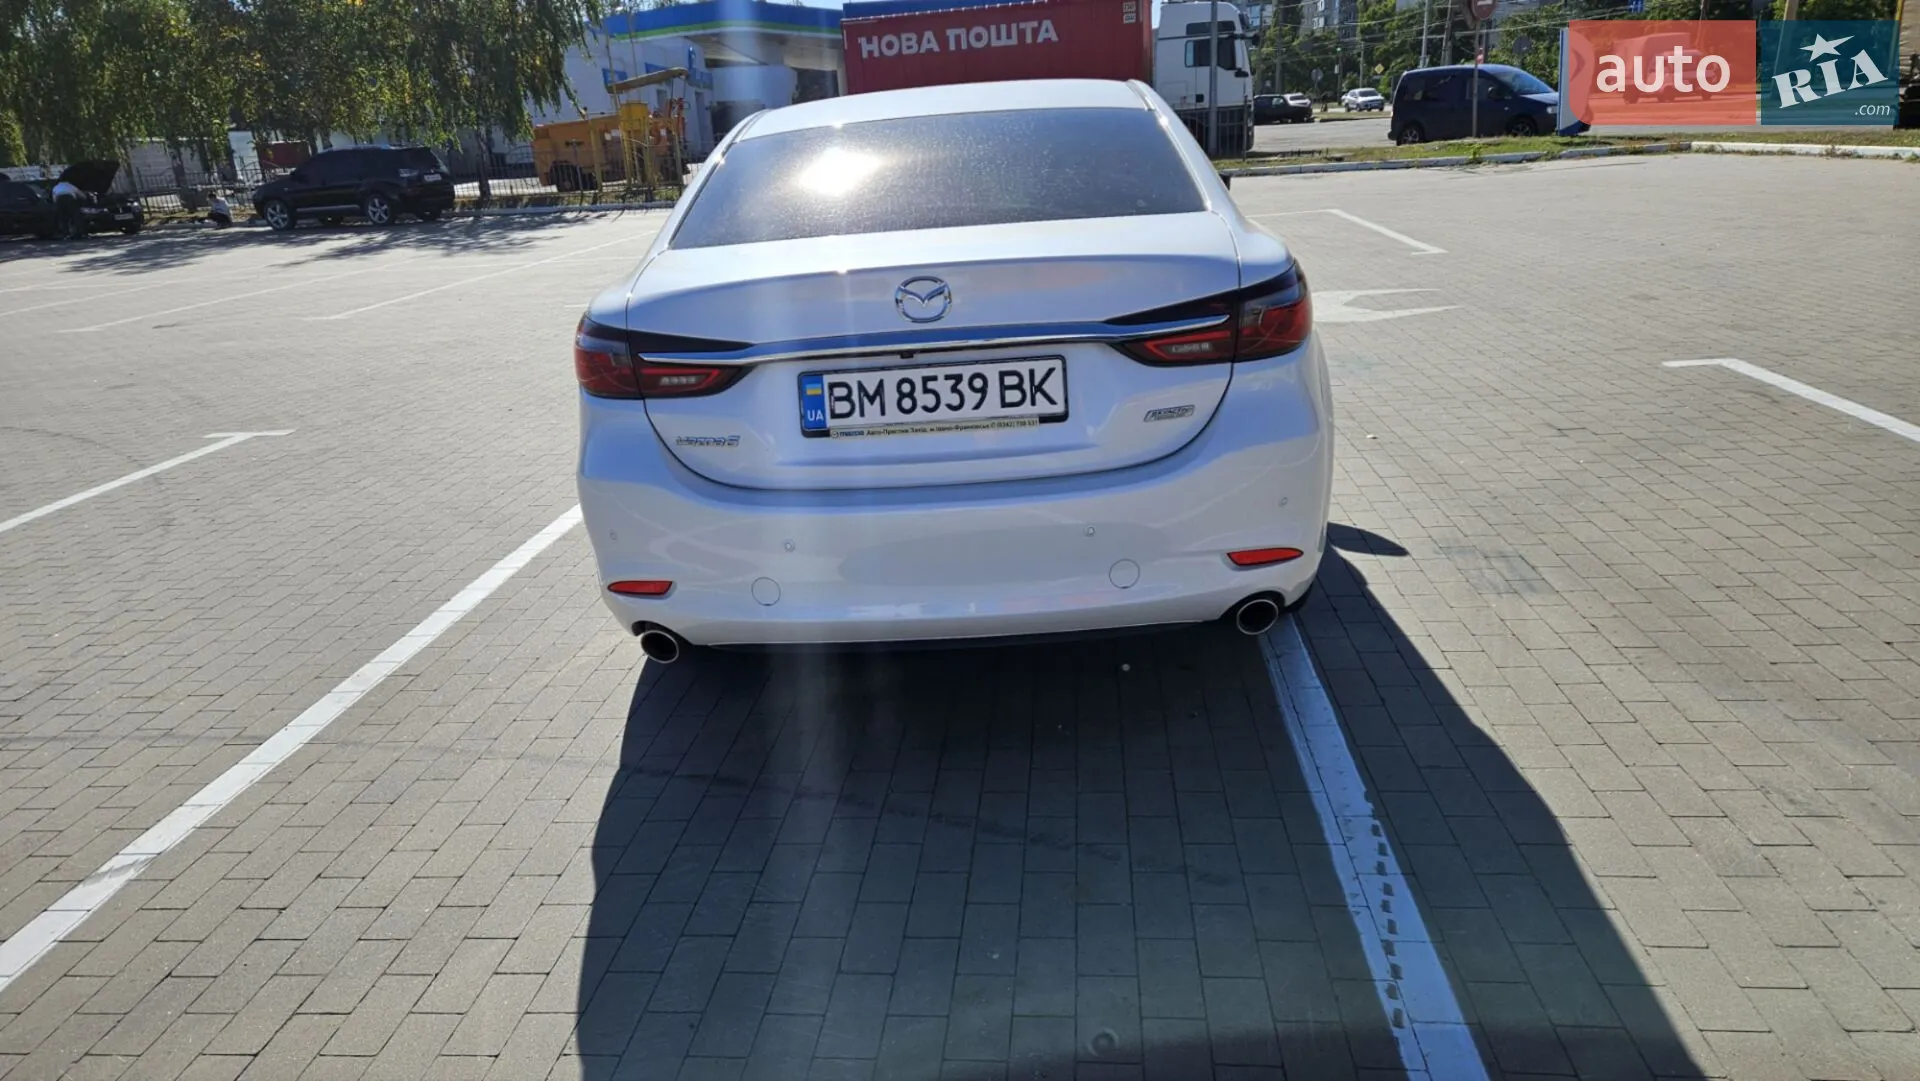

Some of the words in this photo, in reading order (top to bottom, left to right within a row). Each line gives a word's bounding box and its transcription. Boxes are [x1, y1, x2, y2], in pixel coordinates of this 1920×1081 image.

[858, 30, 940, 59] НОВА
[946, 19, 1059, 51] ПОШТА
[827, 378, 886, 420] BM
[896, 372, 989, 415] 8539
[998, 367, 1058, 408] BK
[807, 410, 824, 422] UA
